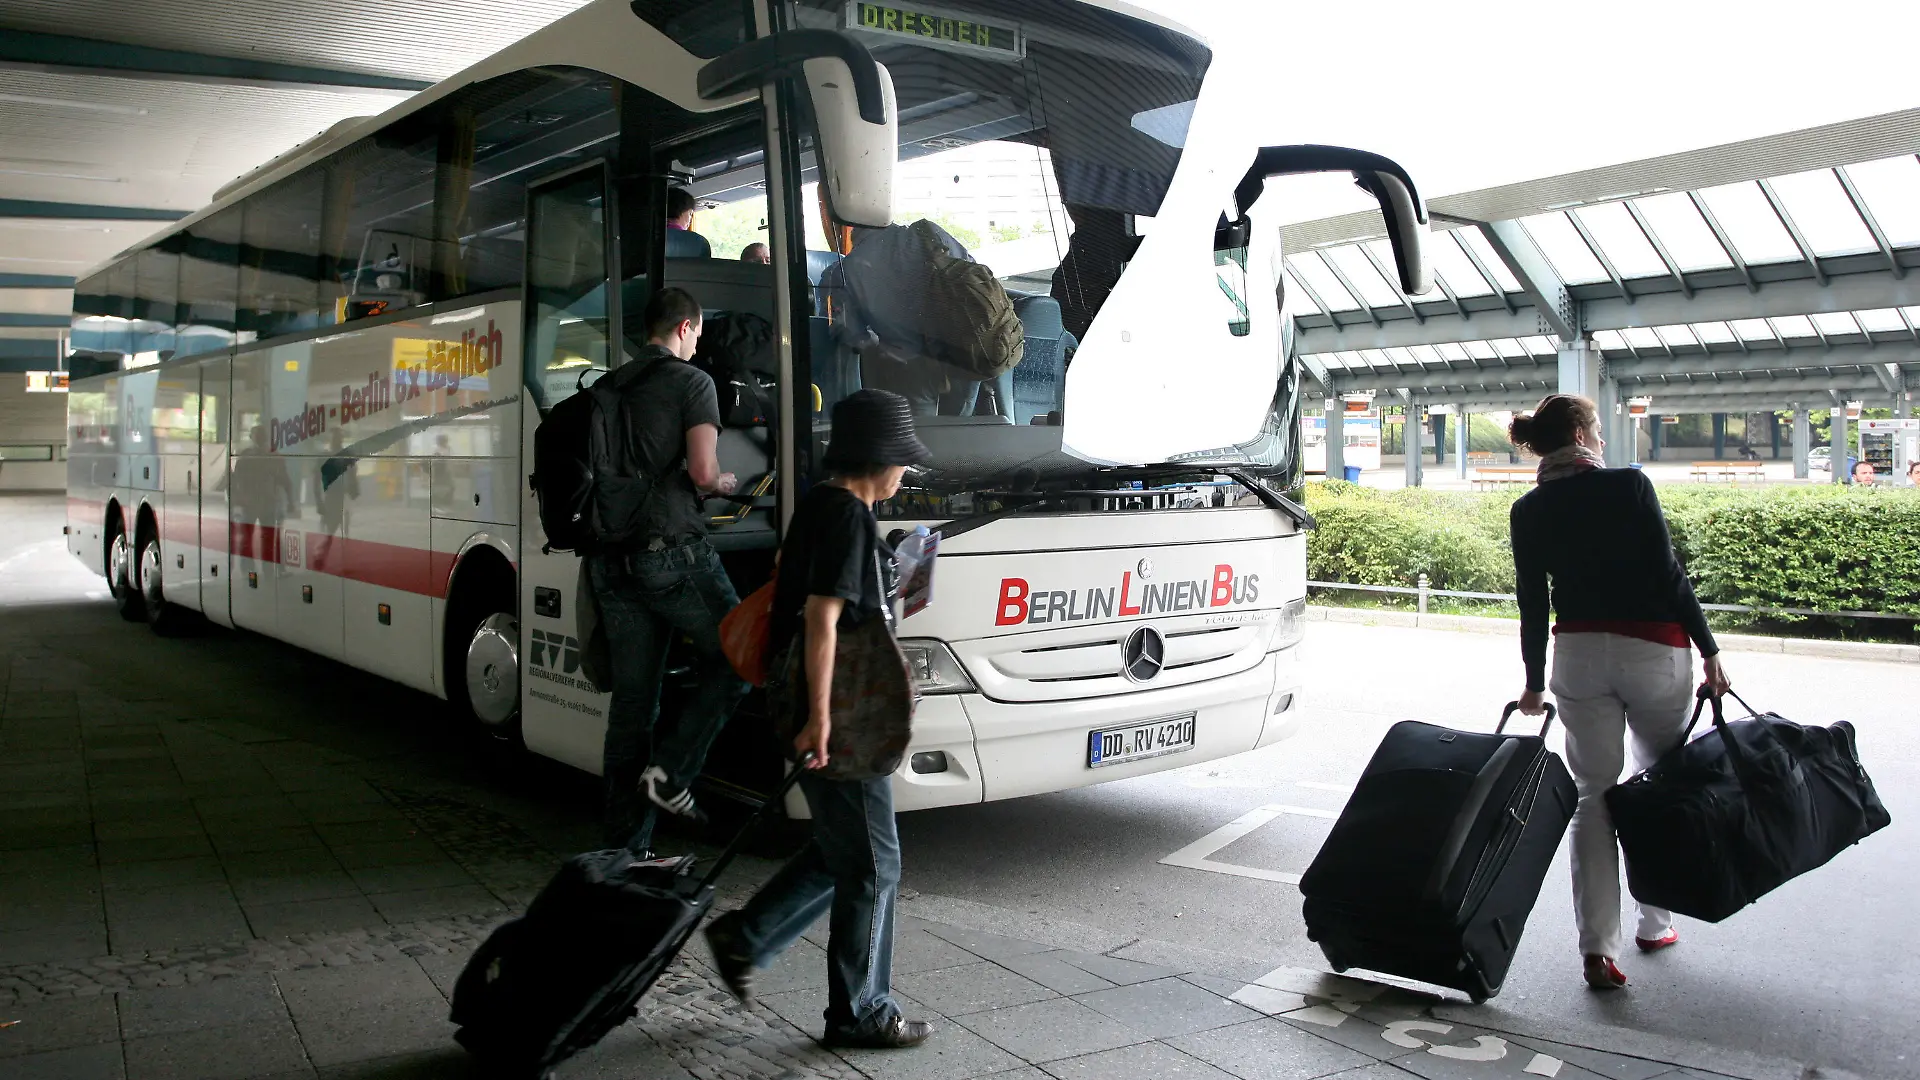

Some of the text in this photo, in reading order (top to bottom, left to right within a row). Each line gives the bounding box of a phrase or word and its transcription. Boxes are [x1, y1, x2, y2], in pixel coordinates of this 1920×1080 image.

[863, 4, 990, 47] DRESDEN
[270, 402, 326, 453] Dresden
[340, 370, 390, 426] Berlin
[425, 319, 503, 396] täglich
[1210, 564, 1260, 607] BUS
[530, 628, 580, 674] RVD
[528, 666, 601, 696] REGIONALVERKEHR DRESD
[582, 703, 603, 718] Dresden
[1102, 733, 1123, 758] DD
[1134, 727, 1154, 753] RV
[1157, 720, 1192, 748] 4210
